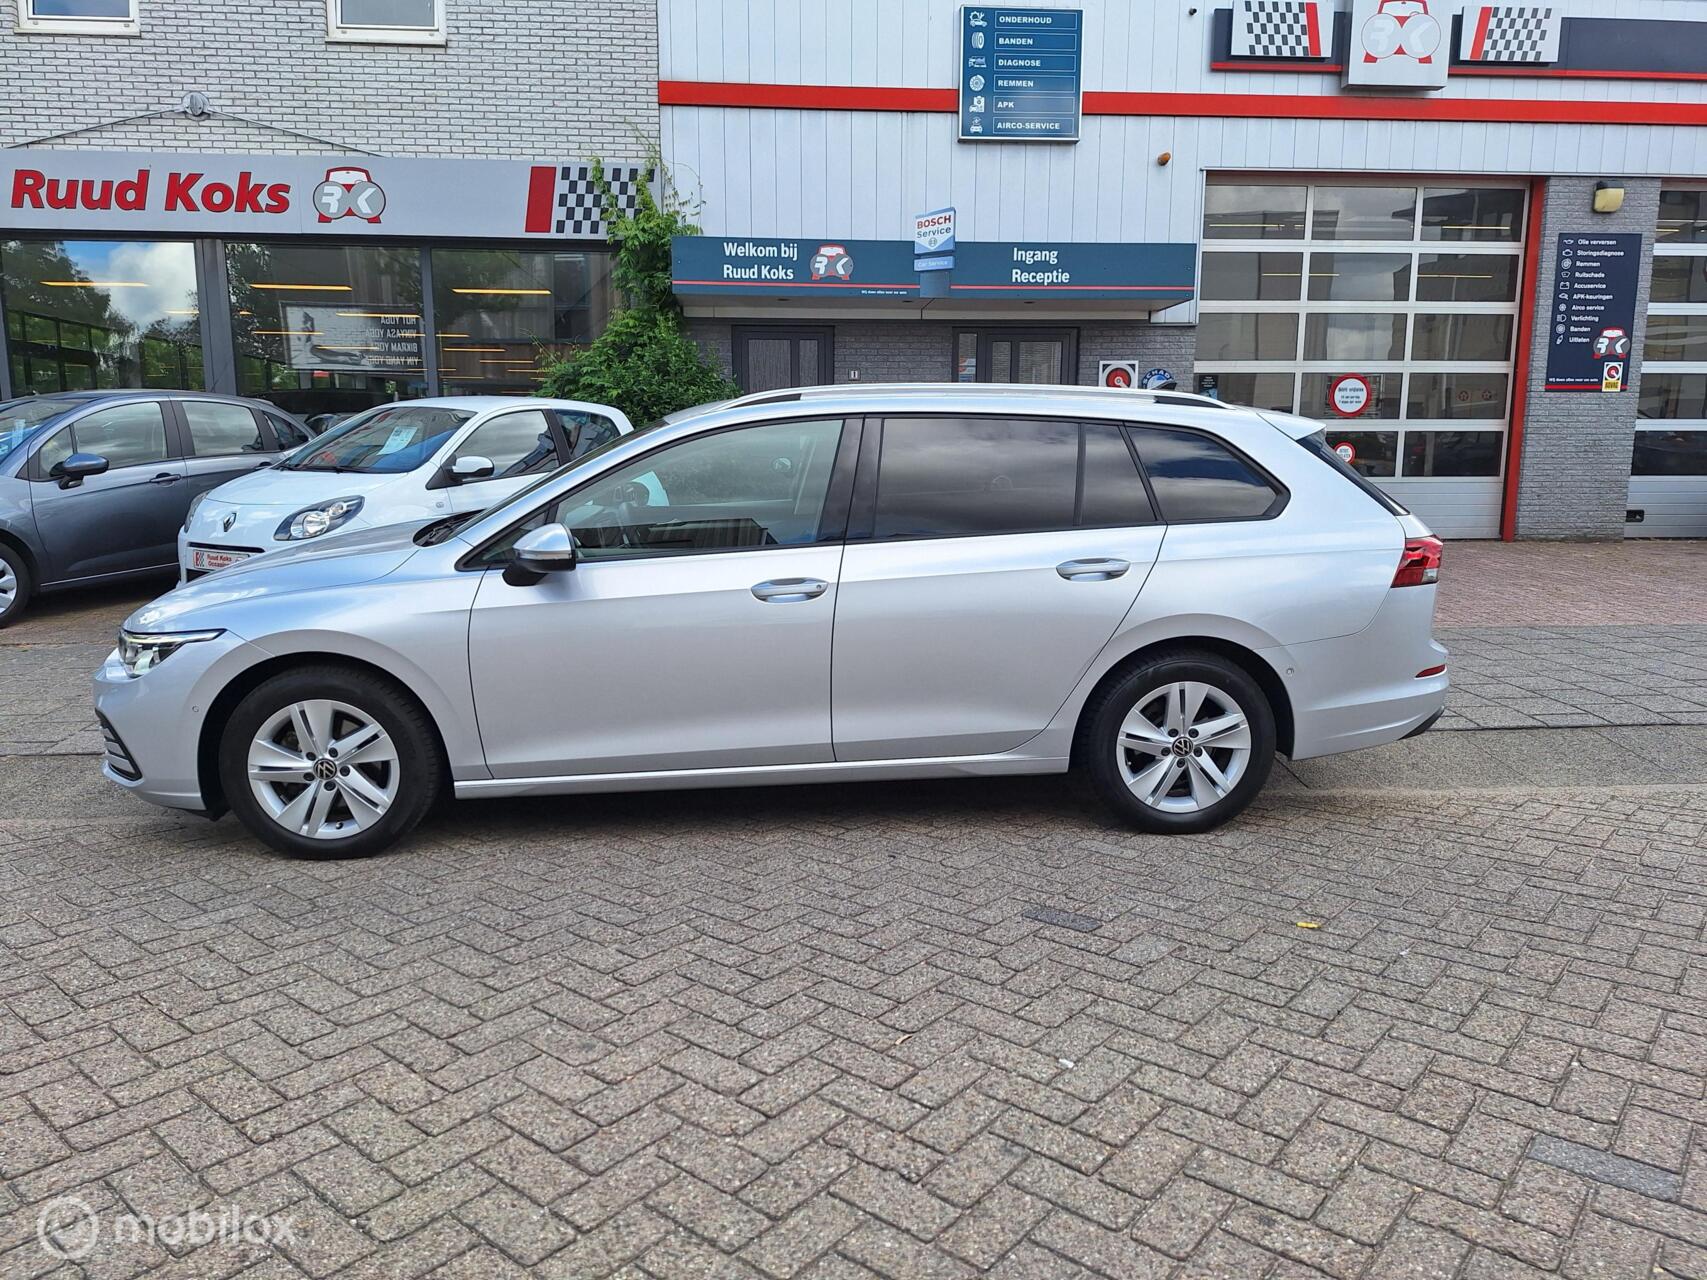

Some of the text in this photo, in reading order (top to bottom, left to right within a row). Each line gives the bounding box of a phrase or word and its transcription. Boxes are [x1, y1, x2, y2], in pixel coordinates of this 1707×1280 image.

[999, 15, 1052, 24] ONDERHOUD
[998, 37, 1034, 46] BANDEN
[998, 59, 1041, 67] DIAGNOSE
[997, 80, 1034, 88] REMMEN
[997, 101, 1015, 109] APK
[996, 122, 1061, 130] AIRCO-SERVICE
[10, 169, 292, 214] Ruud Koks
[916, 214, 952, 230] BOSCH
[916, 226, 952, 239] Service
[723, 241, 798, 261] Welkom bij
[1013, 247, 1059, 265] Ingang
[1576, 249, 1625, 257] Storingsdiagnose
[723, 264, 794, 280] Ruud Koks
[1011, 268, 1070, 286] Receptie
[1572, 293, 1614, 301] APK-keuringen
[1143, 369, 1173, 385] SCHAD
